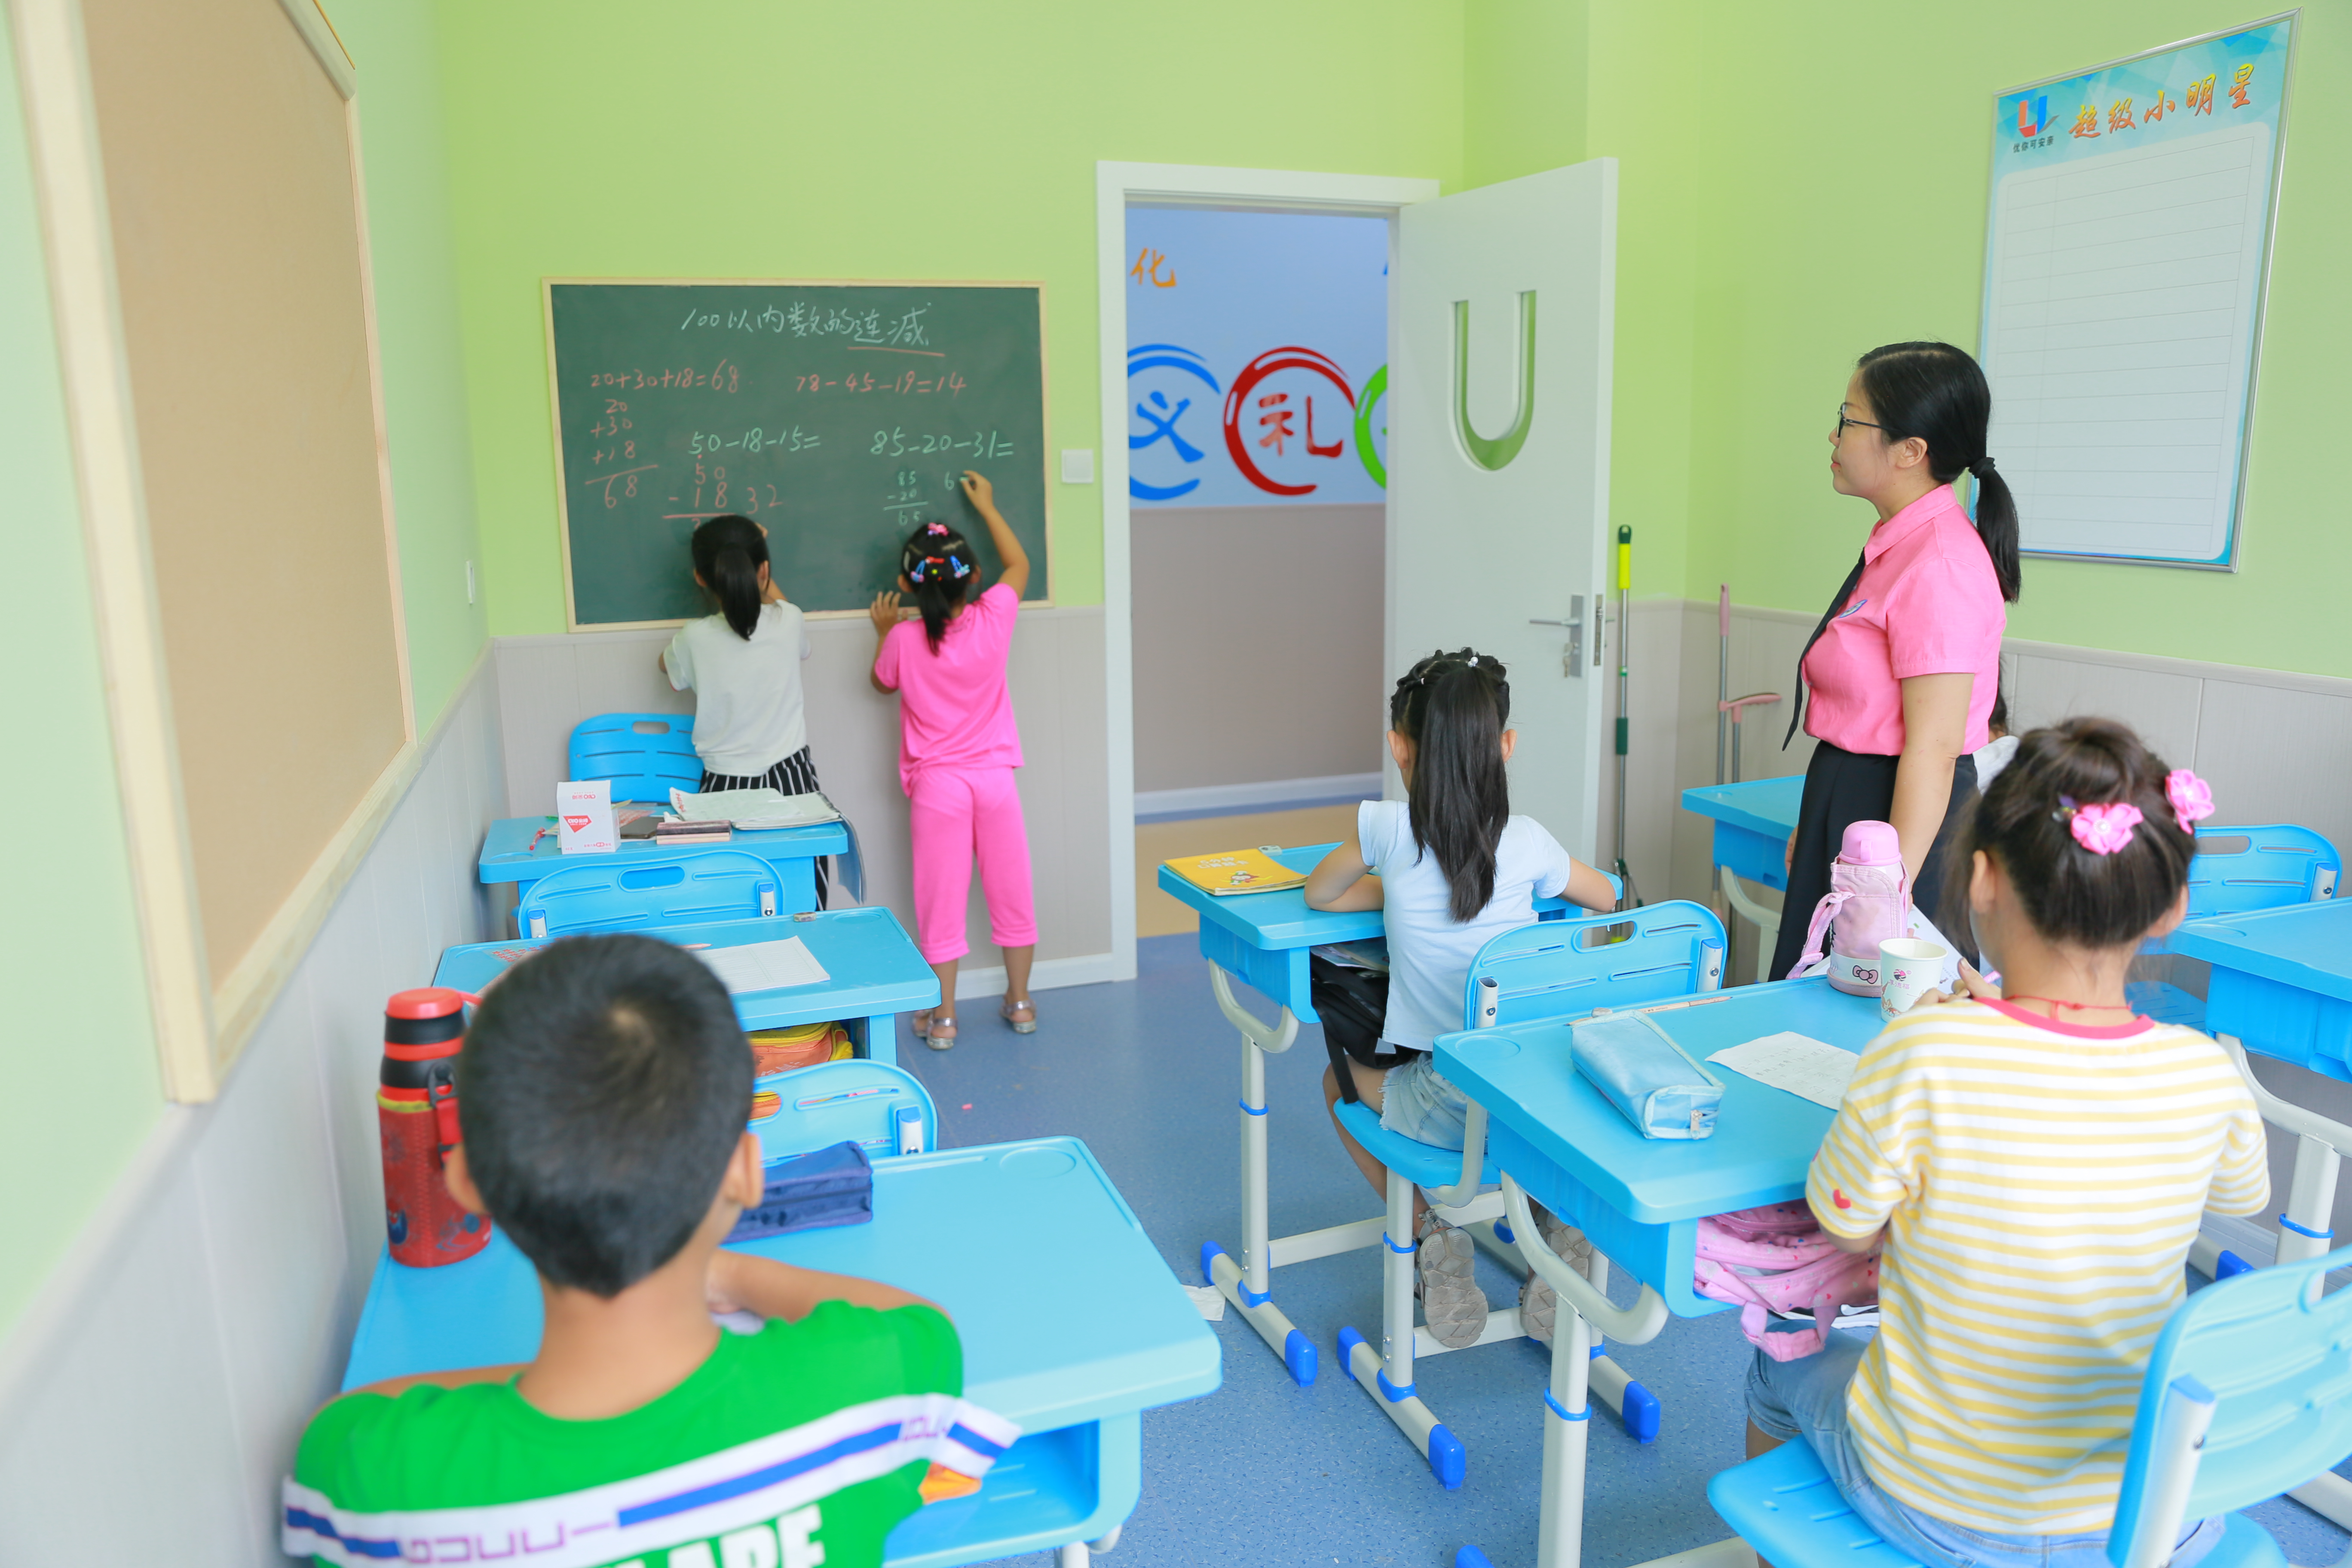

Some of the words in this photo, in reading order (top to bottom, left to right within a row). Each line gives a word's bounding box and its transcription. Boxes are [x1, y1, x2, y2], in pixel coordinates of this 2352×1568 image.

[2068, 63, 2254, 139] 超级小明星
[1130, 248, 1177, 288] 化
[1258, 393, 1344, 459] 礼
